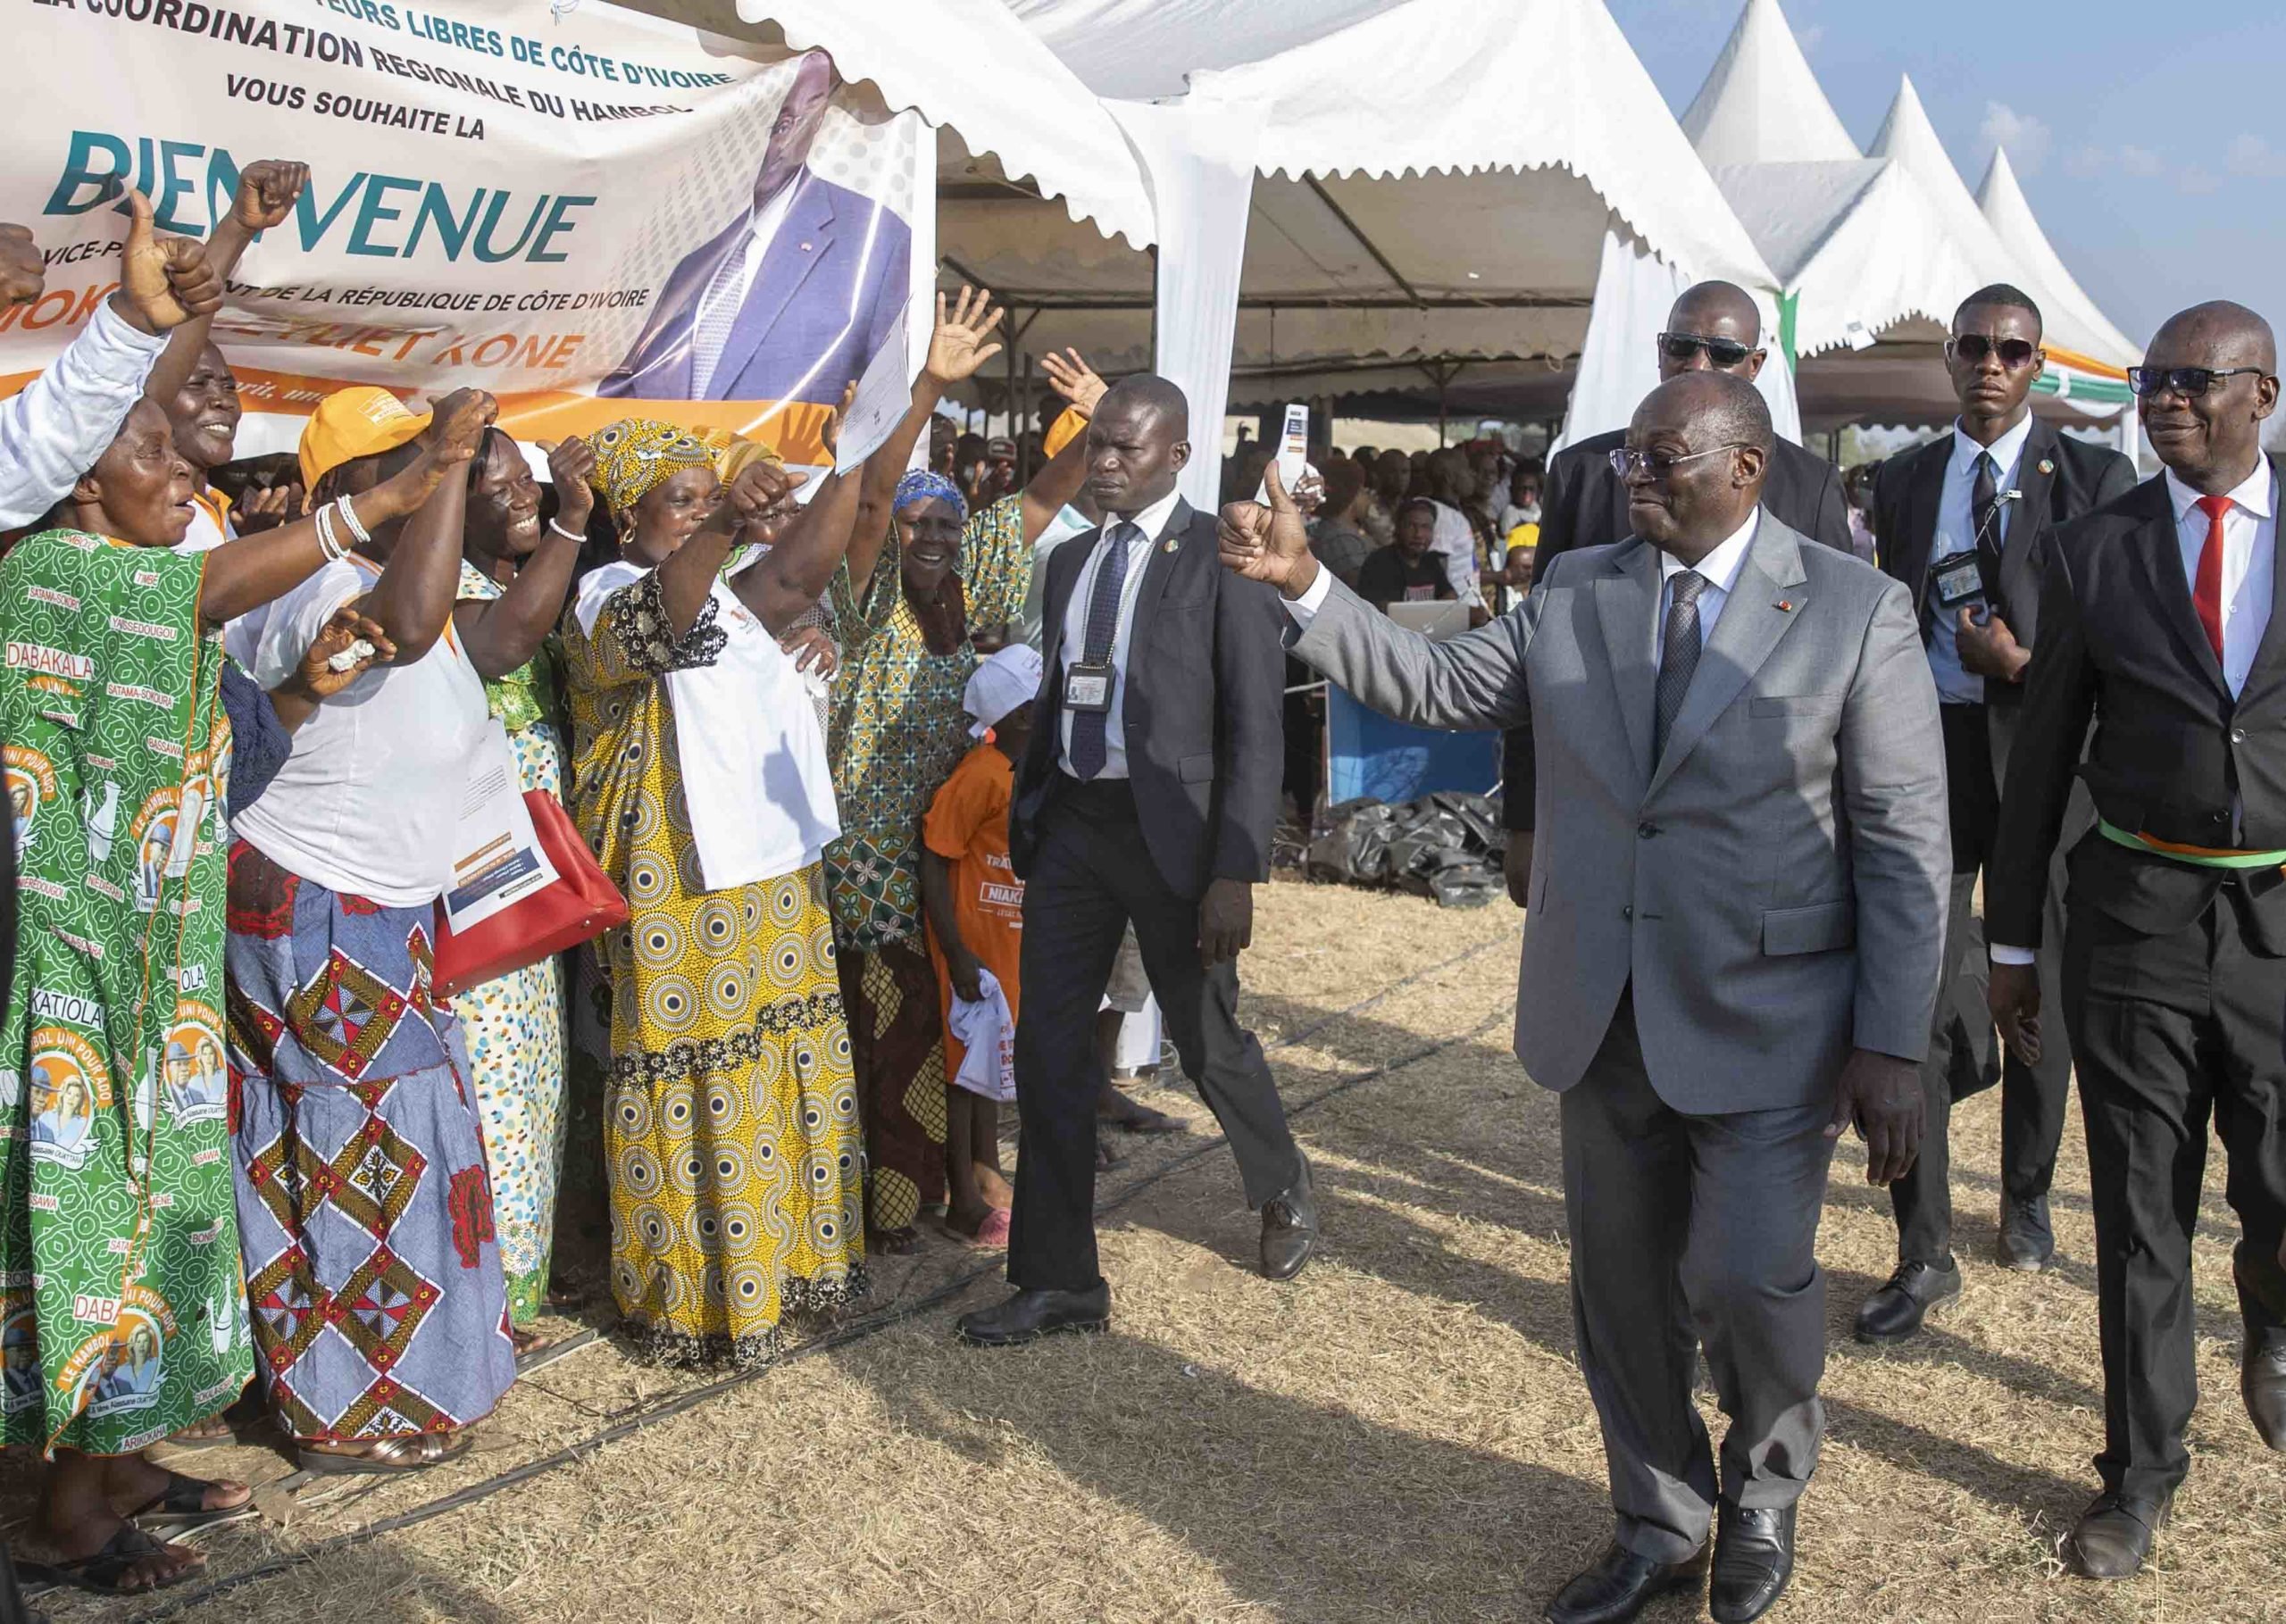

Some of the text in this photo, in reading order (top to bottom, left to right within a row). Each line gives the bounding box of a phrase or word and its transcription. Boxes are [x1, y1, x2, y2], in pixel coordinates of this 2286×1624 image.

[316, 0, 736, 88] EURS LIBRES DE CÔTE D'IVOIRE
[369, 46, 525, 108] REGIONALE
[527, 89, 564, 118] DU
[227, 73, 484, 140] VOUS SOUHAITE LA
[258, 287, 301, 300] DE
[301, 288, 332, 303] LA
[337, 287, 482, 311] RÉPUBLIQUE
[483, 295, 517, 312] DE
[517, 289, 571, 311] CÔTE
[571, 288, 649, 310] D'IVOIRE
[432, 332, 586, 369] KONE
[7, 643, 93, 678] DABAKALA
[25, 752, 48, 774] POUR
[148, 737, 181, 756] BASSAWA
[144, 790, 173, 815] HAMBOL
[32, 991, 102, 1029] KATIOLA
[75, 1044, 104, 1075] POUR
[96, 1077, 112, 1100] ADO
[139, 1290, 165, 1312] POUR
[60, 1335, 109, 1383] LE HAMBOL
[123, 1426, 167, 1449] ARIKOKAHA
